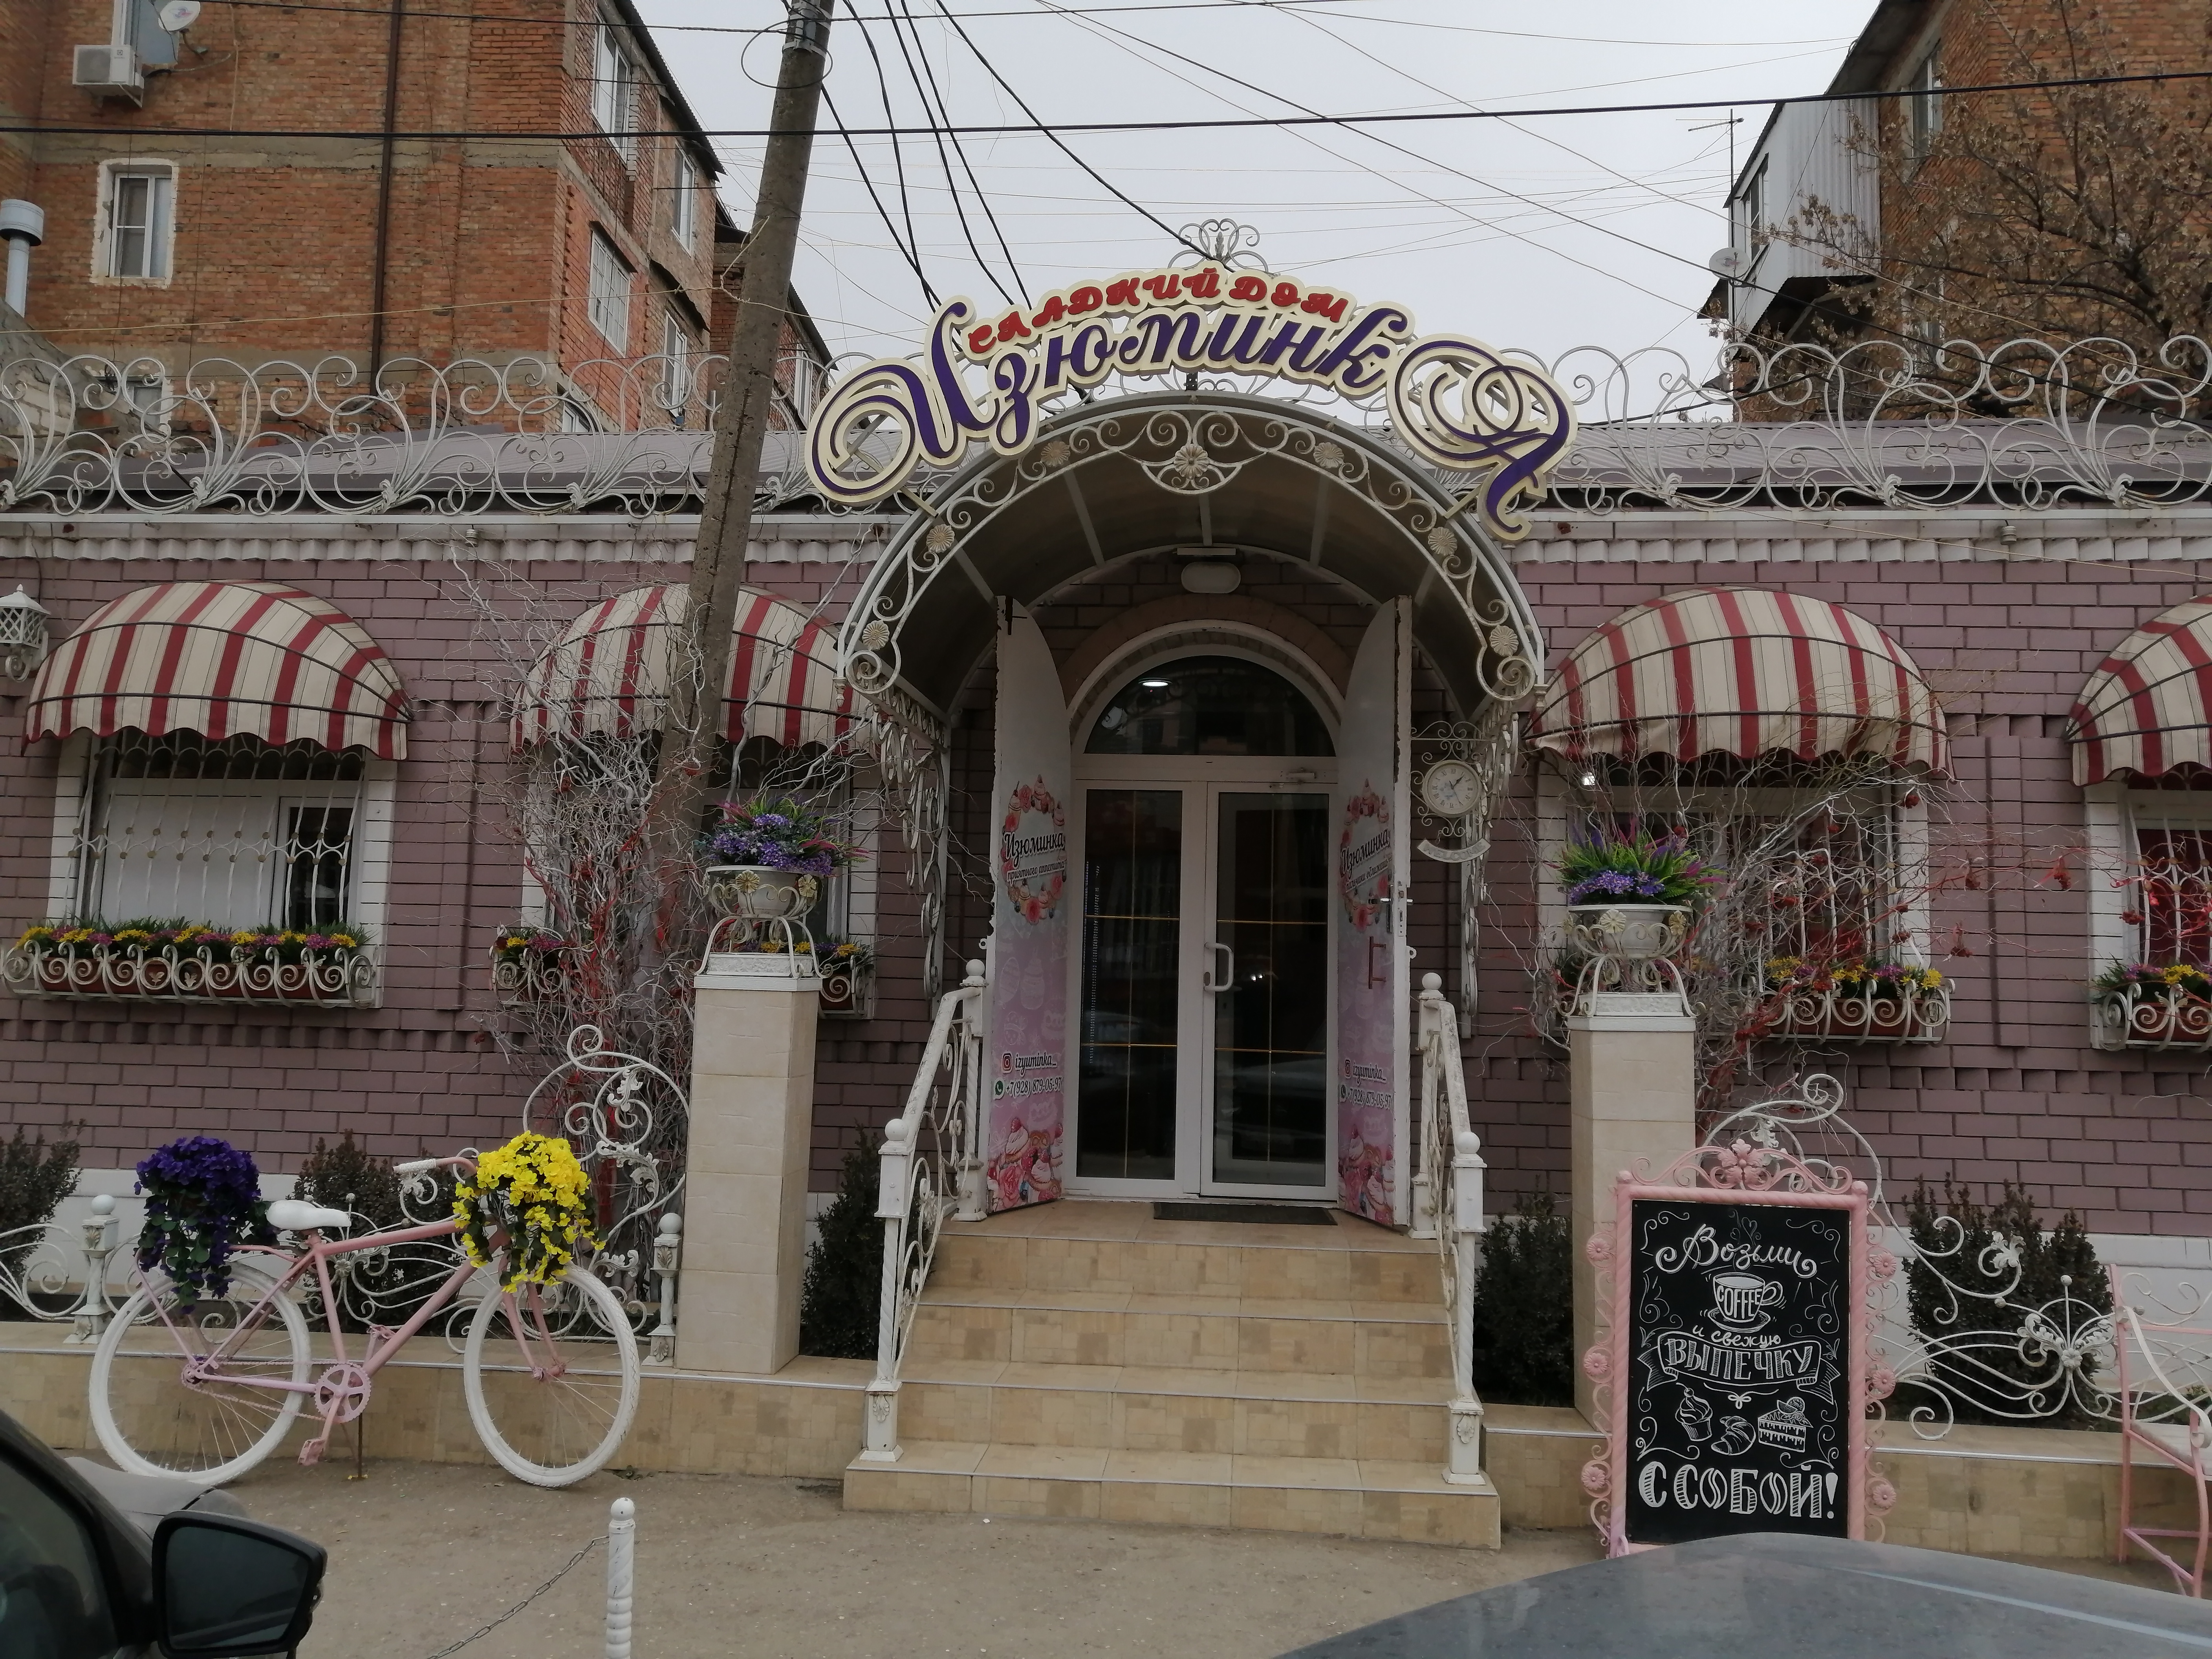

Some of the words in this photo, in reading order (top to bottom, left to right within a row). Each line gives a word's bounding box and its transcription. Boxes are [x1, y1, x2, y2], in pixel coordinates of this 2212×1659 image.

[1004, 832, 1064, 868] Изюминка
[1342, 829, 1389, 879] Изюминка
[1007, 867, 1038, 884] приятного
[1039, 861, 1064, 874] аппетита
[1015, 1052, 1057, 1075] izyuminka_
[1655, 1223, 1817, 1278] Возьми
[1716, 1285, 1763, 1319] COFFEE
[1692, 1325, 1705, 1337] и
[1711, 1330, 1781, 1348] свежую
[1664, 1338, 1813, 1380] ВЫПЕЧКУ
[1674, 1464, 1838, 1519] СОБОЙ!
